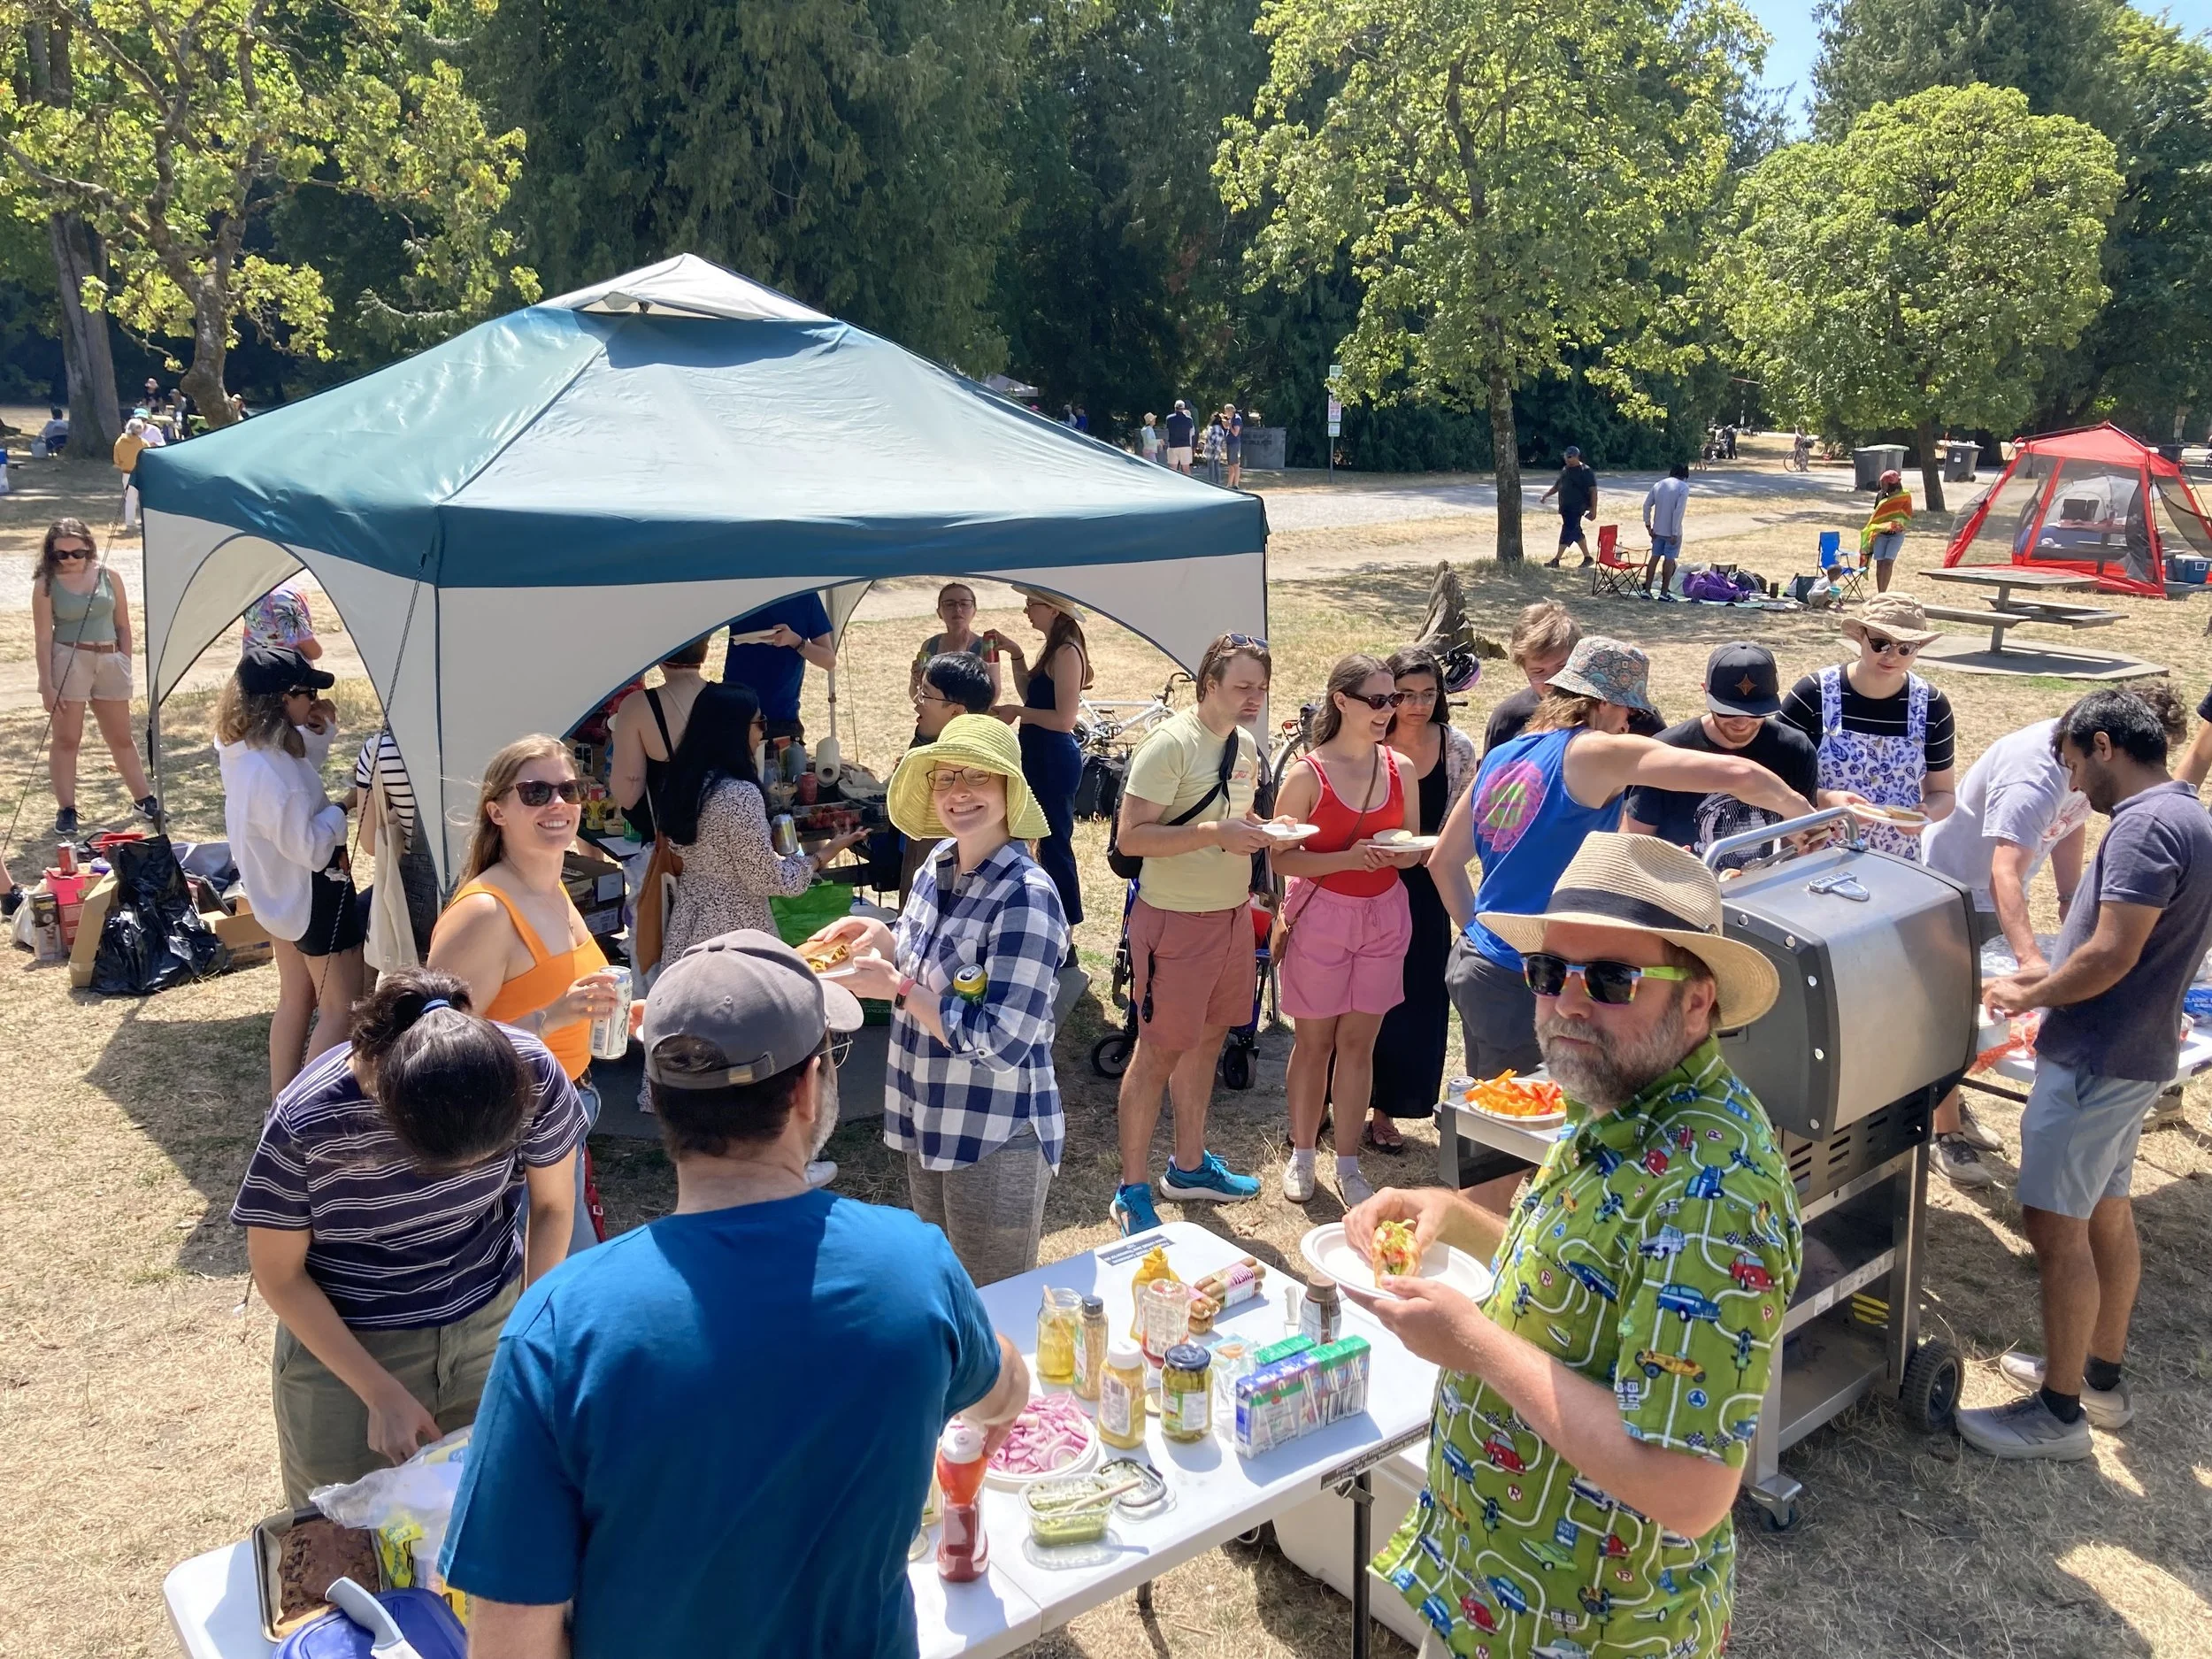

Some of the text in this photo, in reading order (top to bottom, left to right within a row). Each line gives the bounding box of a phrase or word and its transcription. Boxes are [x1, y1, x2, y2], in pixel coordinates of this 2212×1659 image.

[1336, 1458, 1360, 1475] Property
[1390, 1425, 1425, 1448] Conferences
[1322, 1474, 1340, 1490] please
